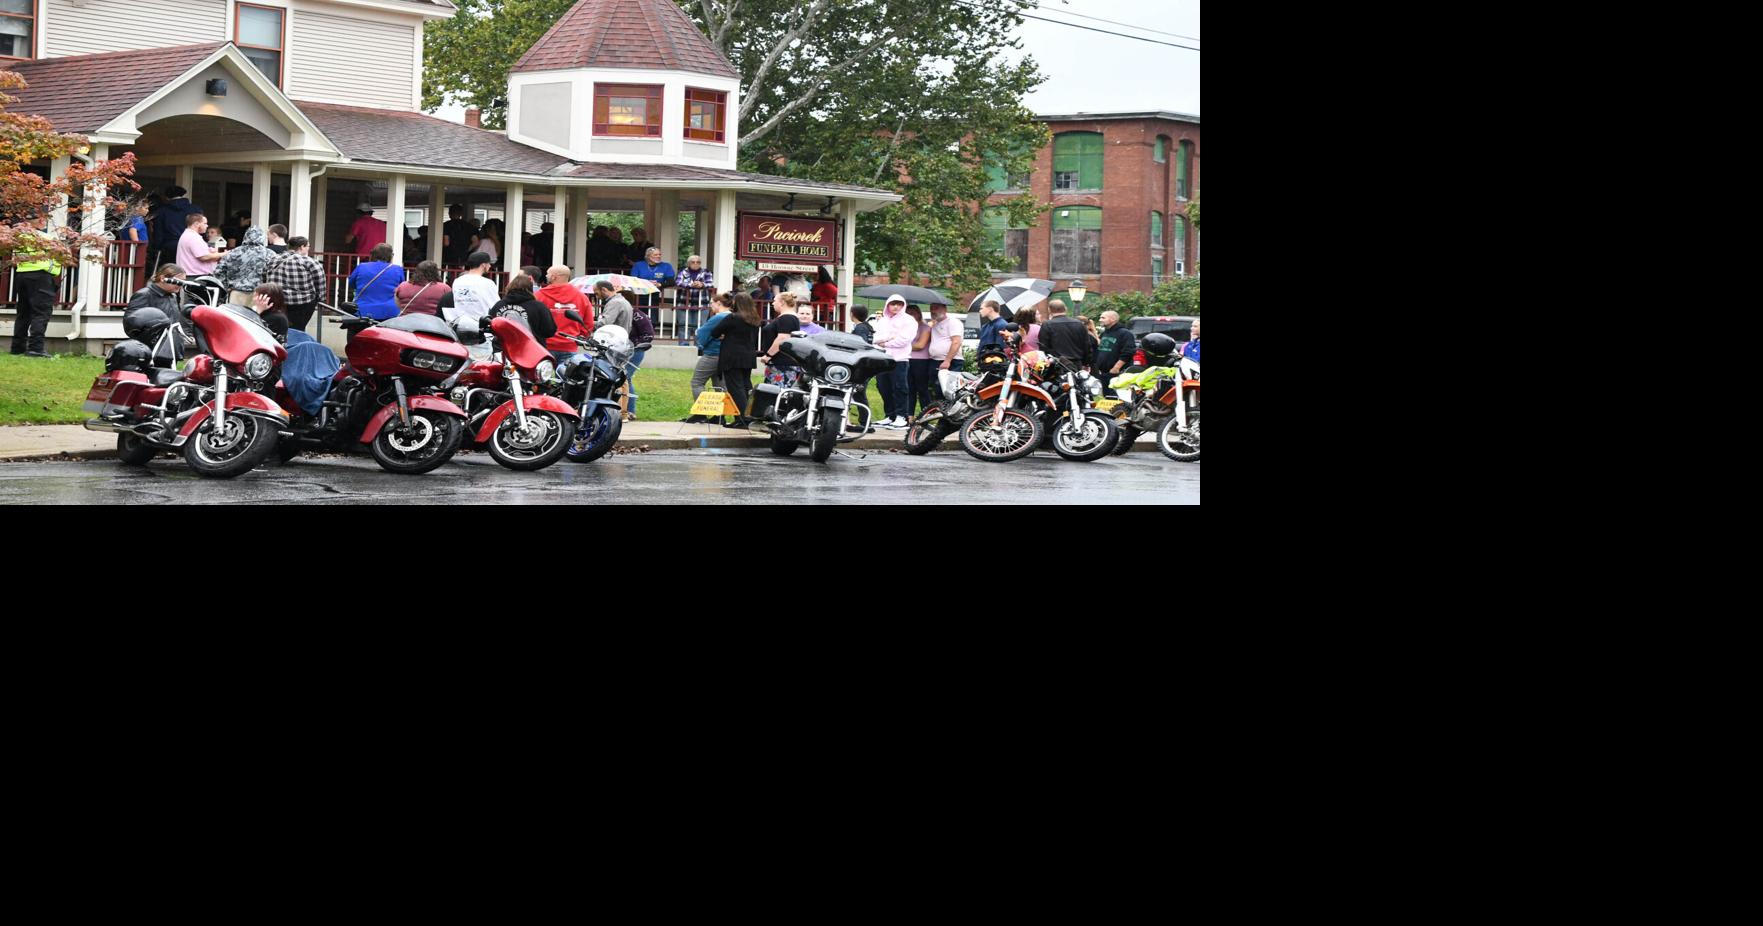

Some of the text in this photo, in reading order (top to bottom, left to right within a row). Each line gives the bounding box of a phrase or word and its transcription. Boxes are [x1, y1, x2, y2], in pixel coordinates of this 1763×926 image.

[753, 221, 825, 243] Paciorek
[750, 243, 827, 256] FUNERAL HOME
